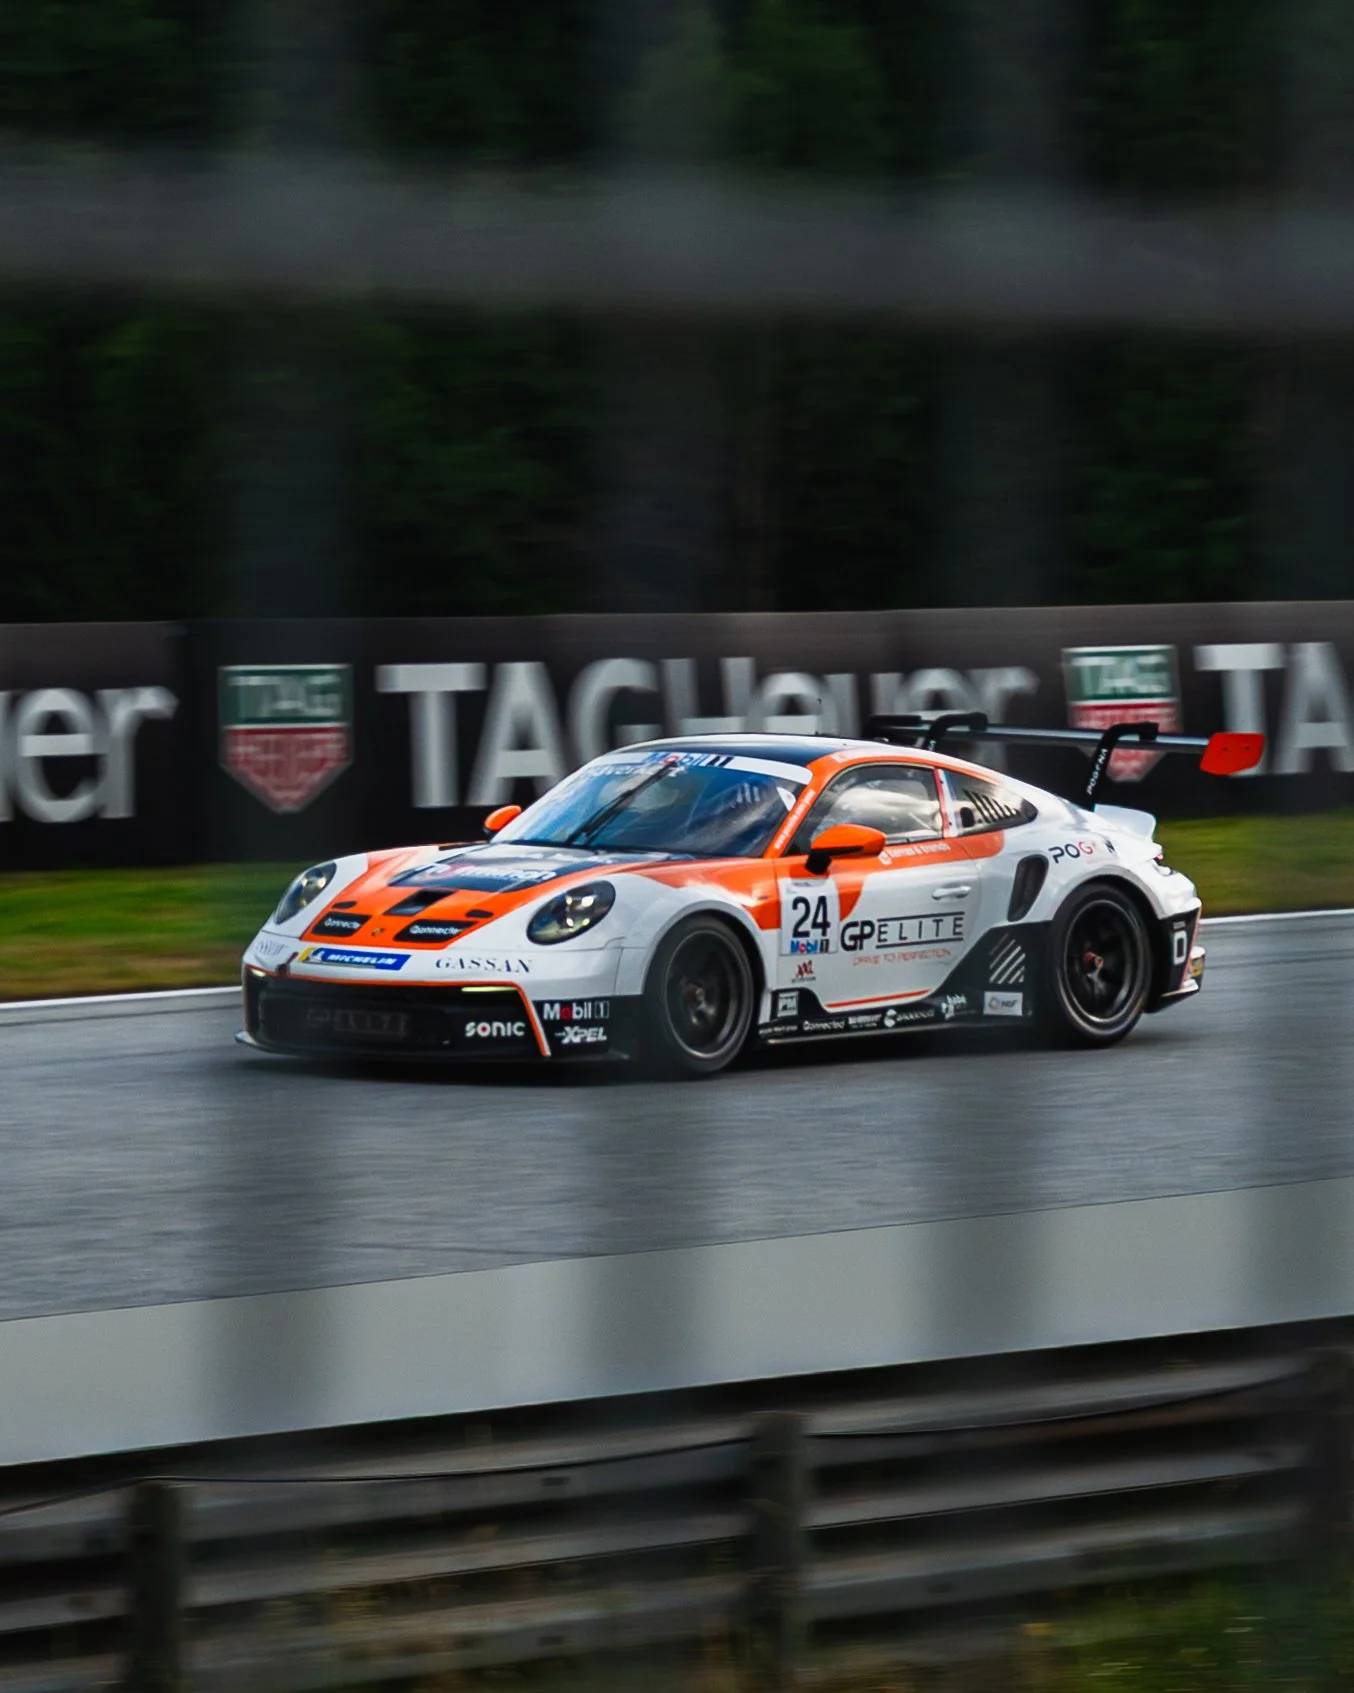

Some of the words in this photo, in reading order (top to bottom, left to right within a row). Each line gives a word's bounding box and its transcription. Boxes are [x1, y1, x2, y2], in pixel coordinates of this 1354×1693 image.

[0, 686, 180, 823] er
[792, 895, 831, 938] 24
[790, 938, 818, 954] Mobil
[327, 952, 398, 966] MICHELIN
[435, 957, 532, 973] GASSAN
[543, 1002, 592, 1020] Mobil
[555, 1026, 607, 1045] XPEL
